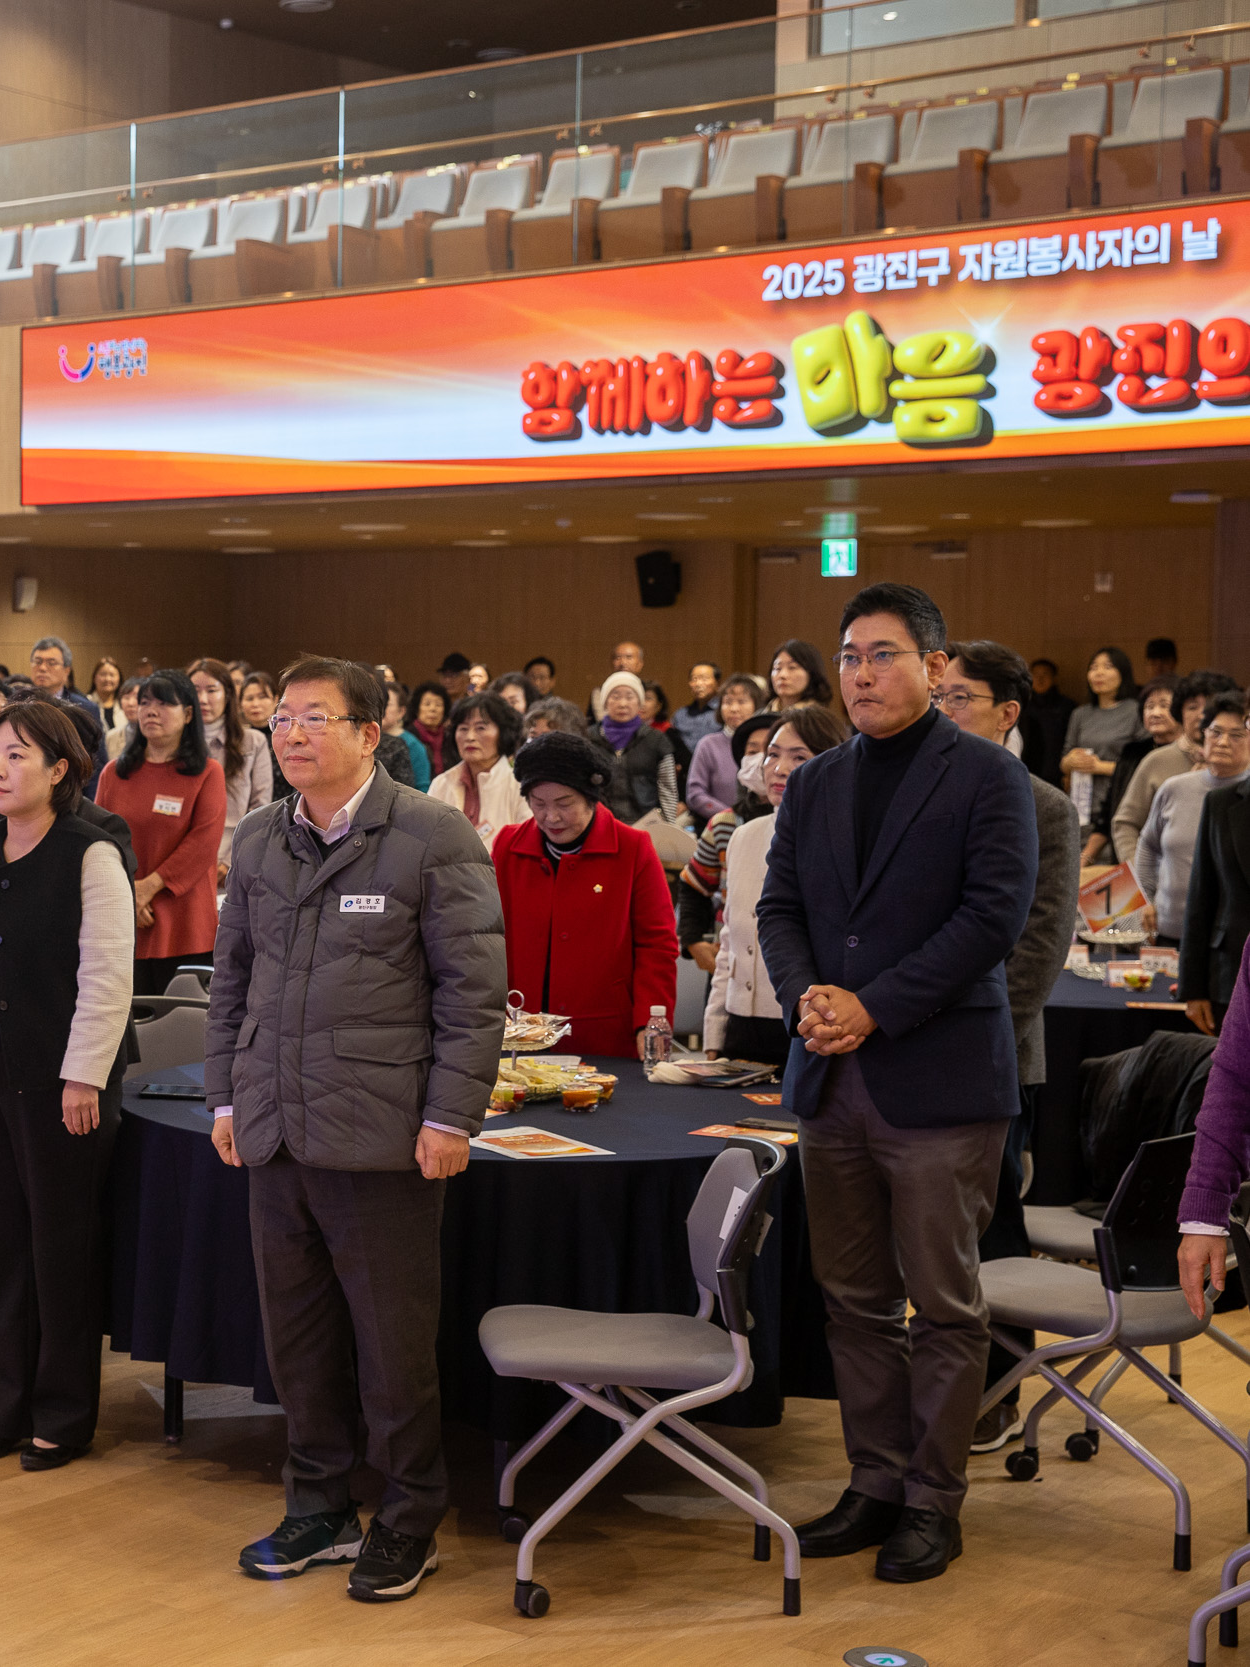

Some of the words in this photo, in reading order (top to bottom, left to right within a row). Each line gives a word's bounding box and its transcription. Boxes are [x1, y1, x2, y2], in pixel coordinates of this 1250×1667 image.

[761, 258, 845, 301] 2025
[852, 246, 951, 293] 광진구
[957, 222, 1172, 282] 자원봉사자의
[1181, 217, 1222, 262] 날
[521, 349, 780, 438] 함께하는
[792, 309, 989, 444] 마음
